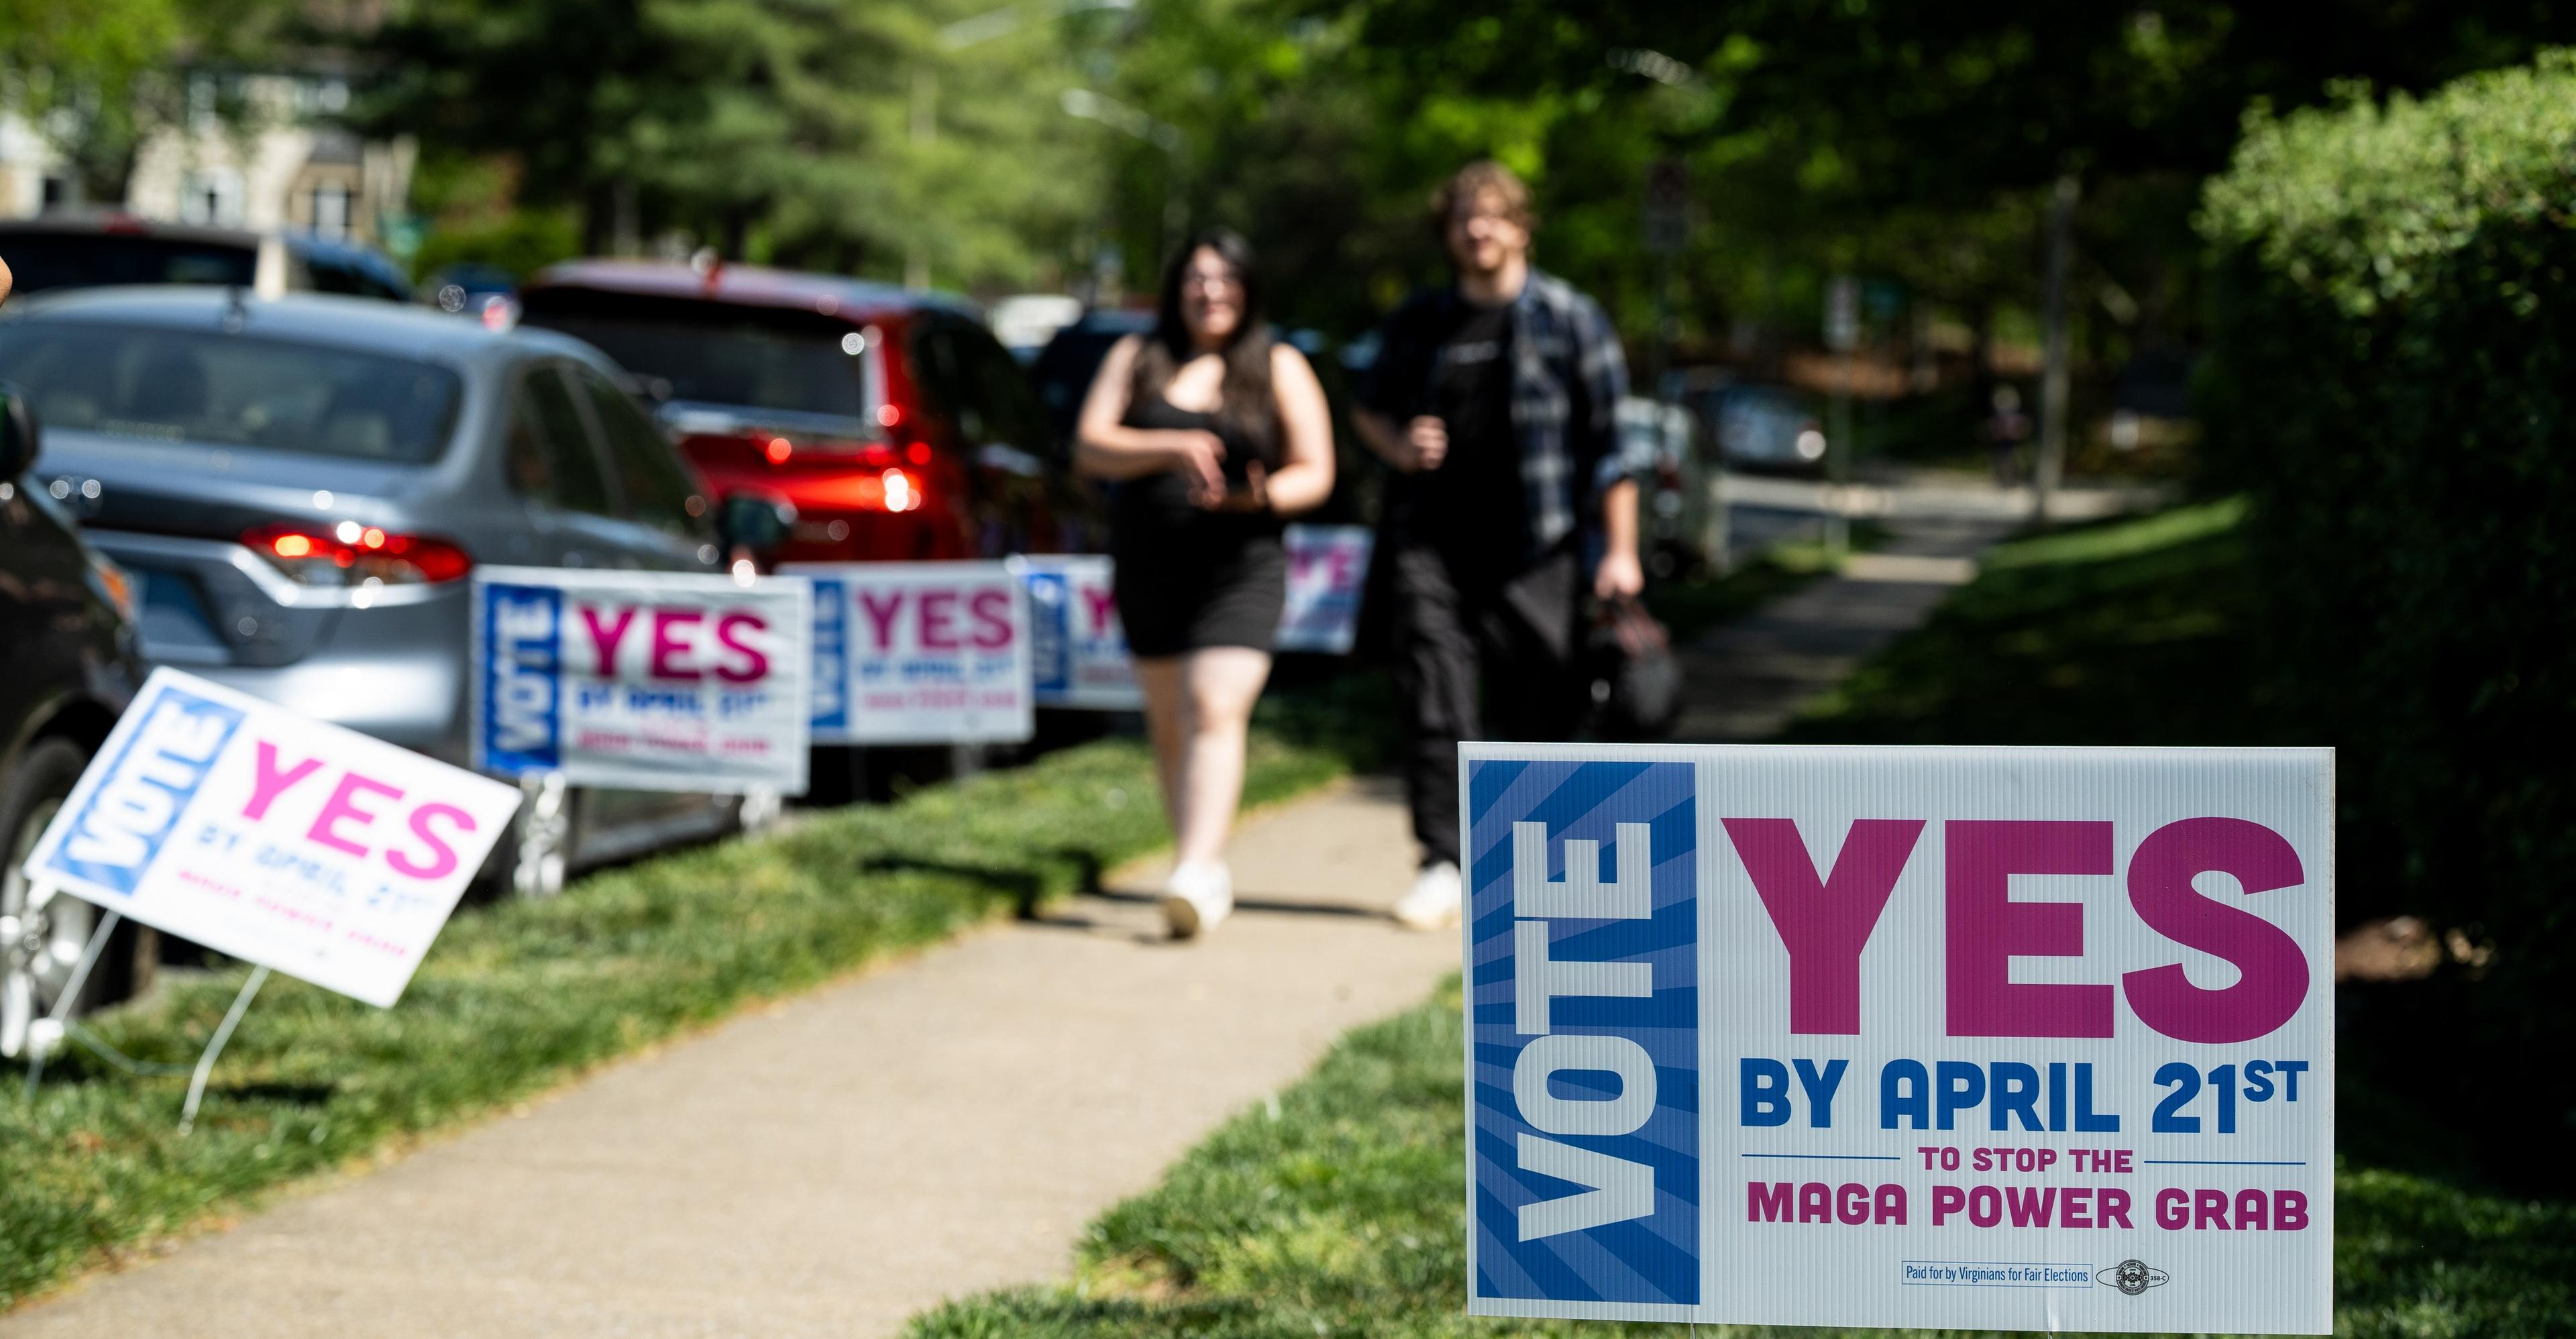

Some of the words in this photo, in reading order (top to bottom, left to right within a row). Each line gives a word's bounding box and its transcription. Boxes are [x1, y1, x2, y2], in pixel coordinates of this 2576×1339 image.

[578, 604, 771, 685] YES
[860, 588, 1016, 652] YES
[494, 596, 555, 753] VOTE
[66, 702, 225, 867] VOTE
[242, 740, 477, 880] YES
[1722, 817, 2309, 1044] YES
[1512, 821, 1657, 1242] VOTE
[1740, 1057, 1849, 1129] BY
[1880, 1058, 2121, 1134] APRIL
[2151, 1059, 2310, 1135] 21ST
[1919, 1147, 1960, 1171] TO
[1974, 1148, 2057, 1172] STOP
[2070, 1149, 2133, 1173] THE
[1748, 1182, 1907, 1225] MAGA
[1933, 1185, 2133, 1229] POWER
[2156, 1188, 2308, 1230] GRAB
[1906, 1265, 1927, 1279] Paid
[1929, 1266, 1943, 1279] for
[1945, 1267, 1957, 1283] by
[1959, 1266, 2006, 1283] Virginians
[2008, 1267, 2022, 1281] for
[2025, 1268, 2042, 1282] Fair
[2044, 1268, 2089, 1283] Elections
